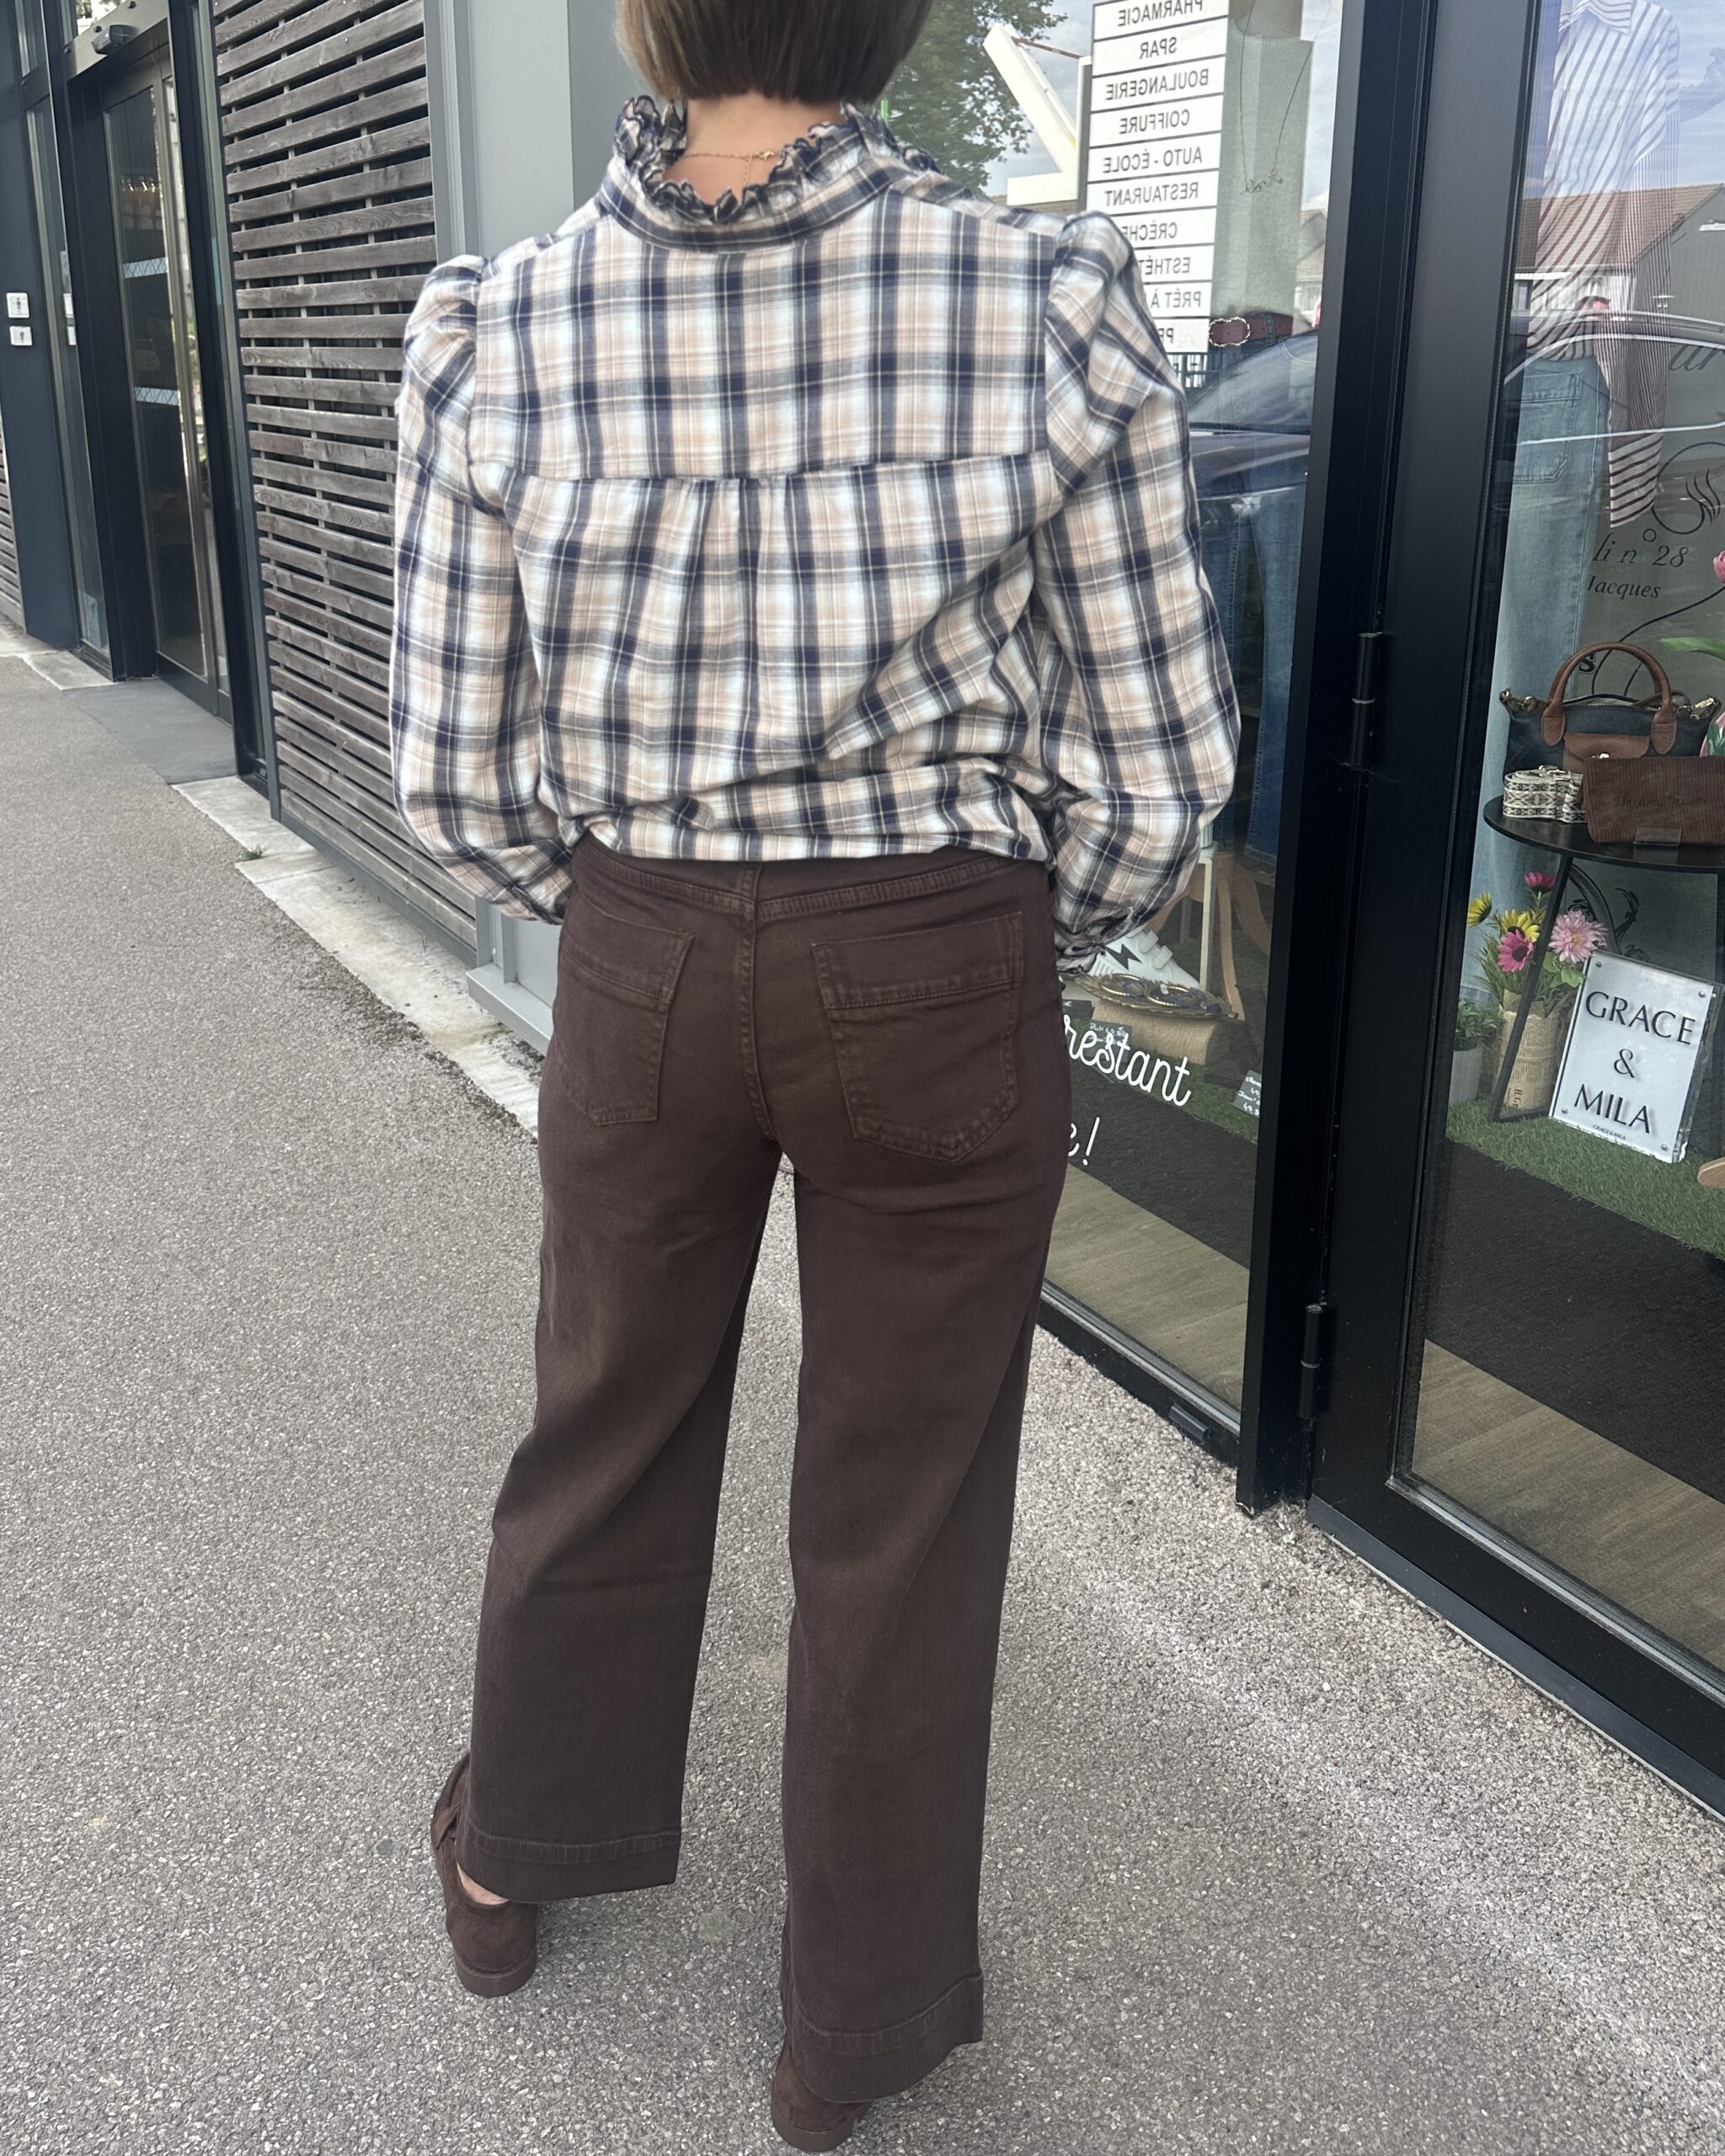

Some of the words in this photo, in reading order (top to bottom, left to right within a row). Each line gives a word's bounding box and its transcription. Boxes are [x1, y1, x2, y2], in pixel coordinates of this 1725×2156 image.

[1585, 991, 1696, 1045] GRACE
[1613, 1049, 1636, 1079] &
[1574, 1084, 1651, 1134] MILA
